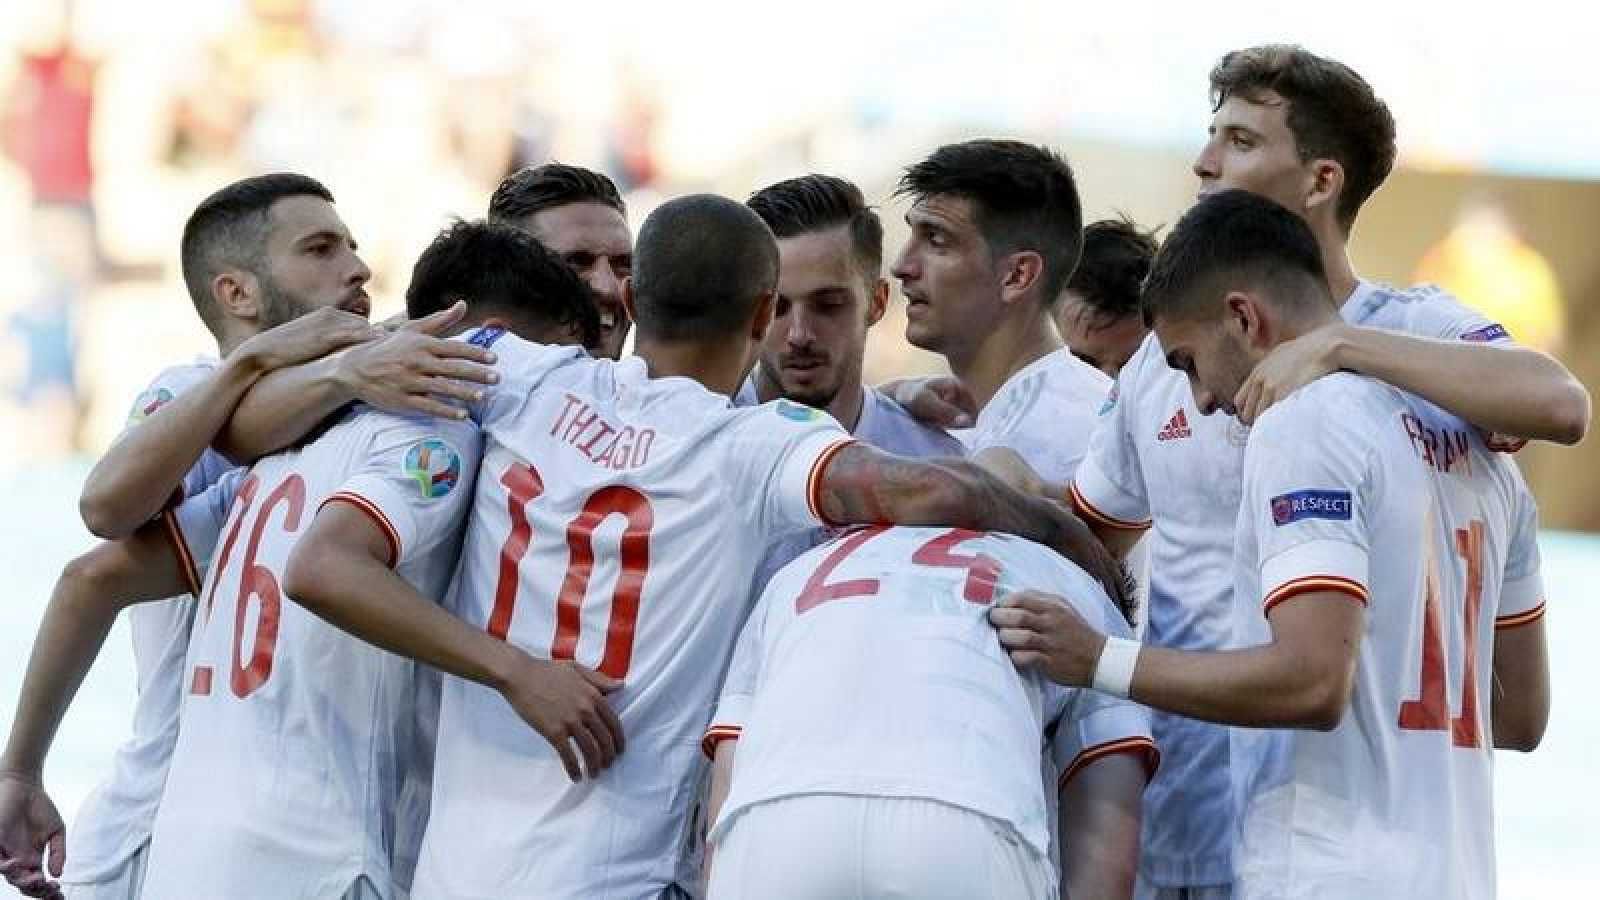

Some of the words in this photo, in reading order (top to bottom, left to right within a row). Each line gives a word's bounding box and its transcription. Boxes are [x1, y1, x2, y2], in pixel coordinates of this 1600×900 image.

[550, 393, 656, 470] THIAGO
[1293, 497, 1350, 513] RESPECT
[487, 462, 654, 684] 10
[1398, 520, 1484, 748] 11
